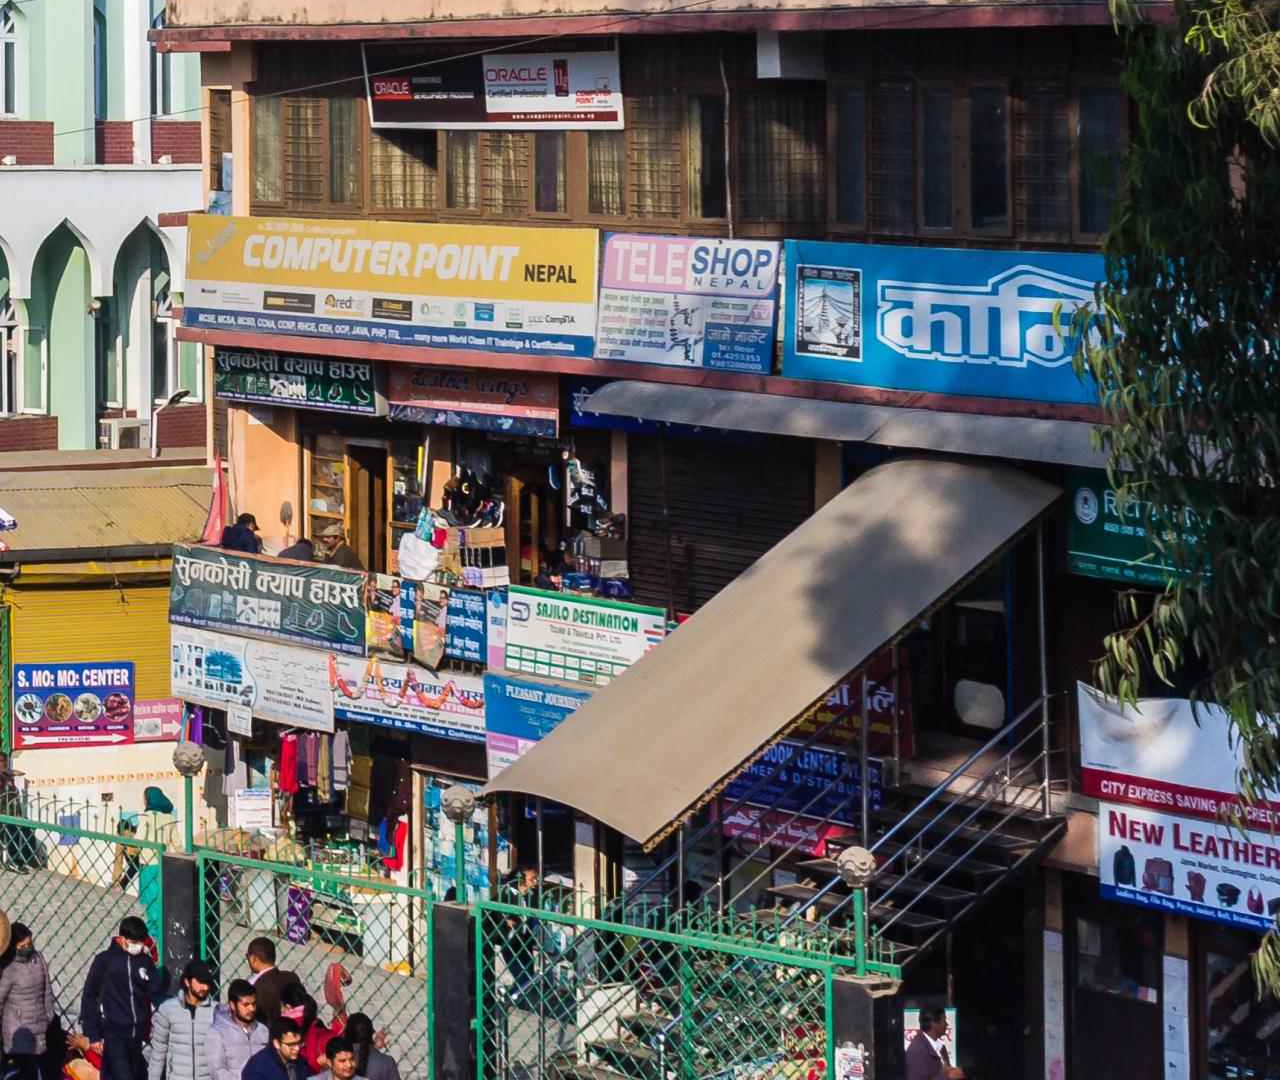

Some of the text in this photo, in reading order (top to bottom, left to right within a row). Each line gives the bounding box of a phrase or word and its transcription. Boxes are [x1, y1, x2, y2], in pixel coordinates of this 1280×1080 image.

[486, 67, 547, 82] ORACLE
[374, 82, 409, 94] ORACLE
[488, 88, 547, 98] Certified Professional
[243, 234, 412, 278] COMPUTER
[412, 242, 520, 282] POINT
[523, 263, 577, 284] NEPAL
[612, 240, 772, 286] TELE SHOP
[693, 276, 765, 290] NEPAL
[198, 313, 217, 324] MCSE,
[217, 315, 236, 326] MCSA,
[237, 316, 256, 327] MCSD,
[257, 318, 276, 329] CCNA,
[277, 320, 296, 331] CCNP,
[297, 322, 317, 333] RHCE,
[318, 324, 334, 334] CEH,
[335, 325, 350, 336] OCP,
[351, 326, 370, 337] JAVA,
[371, 328, 387, 339] PHP,
[432, 335, 448, 343] more
[448, 334, 468, 345] World
[468, 336, 486, 346] Class
[494, 337, 524, 350] Trainings
[532, 340, 575, 352] Certifications
[217, 350, 371, 381] सुनकोसी क्याप हाउस
[410, 370, 529, 405] Leather Wings
[175, 554, 359, 610] सुनकोसी क्याप हाउस
[535, 601, 639, 633] SAJILO DESTINATION
[572, 628, 594, 641] TRAVELS
[17, 668, 129, 689] S. MO: MO: CENTER
[505, 684, 544, 704] PLEASANT
[421, 724, 446, 736] Books
[1100, 779, 1126, 796] CITY
[1127, 784, 1175, 806] EXPRESS
[1175, 793, 1217, 813] SAVING
[1108, 809, 1280, 870] NEW LEATHER
[1197, 860, 1220, 873] Market,
[1115, 887, 1135, 900] Ladies
[1135, 893, 1150, 904] Bag,
[1161, 898, 1176, 910] Bag,
